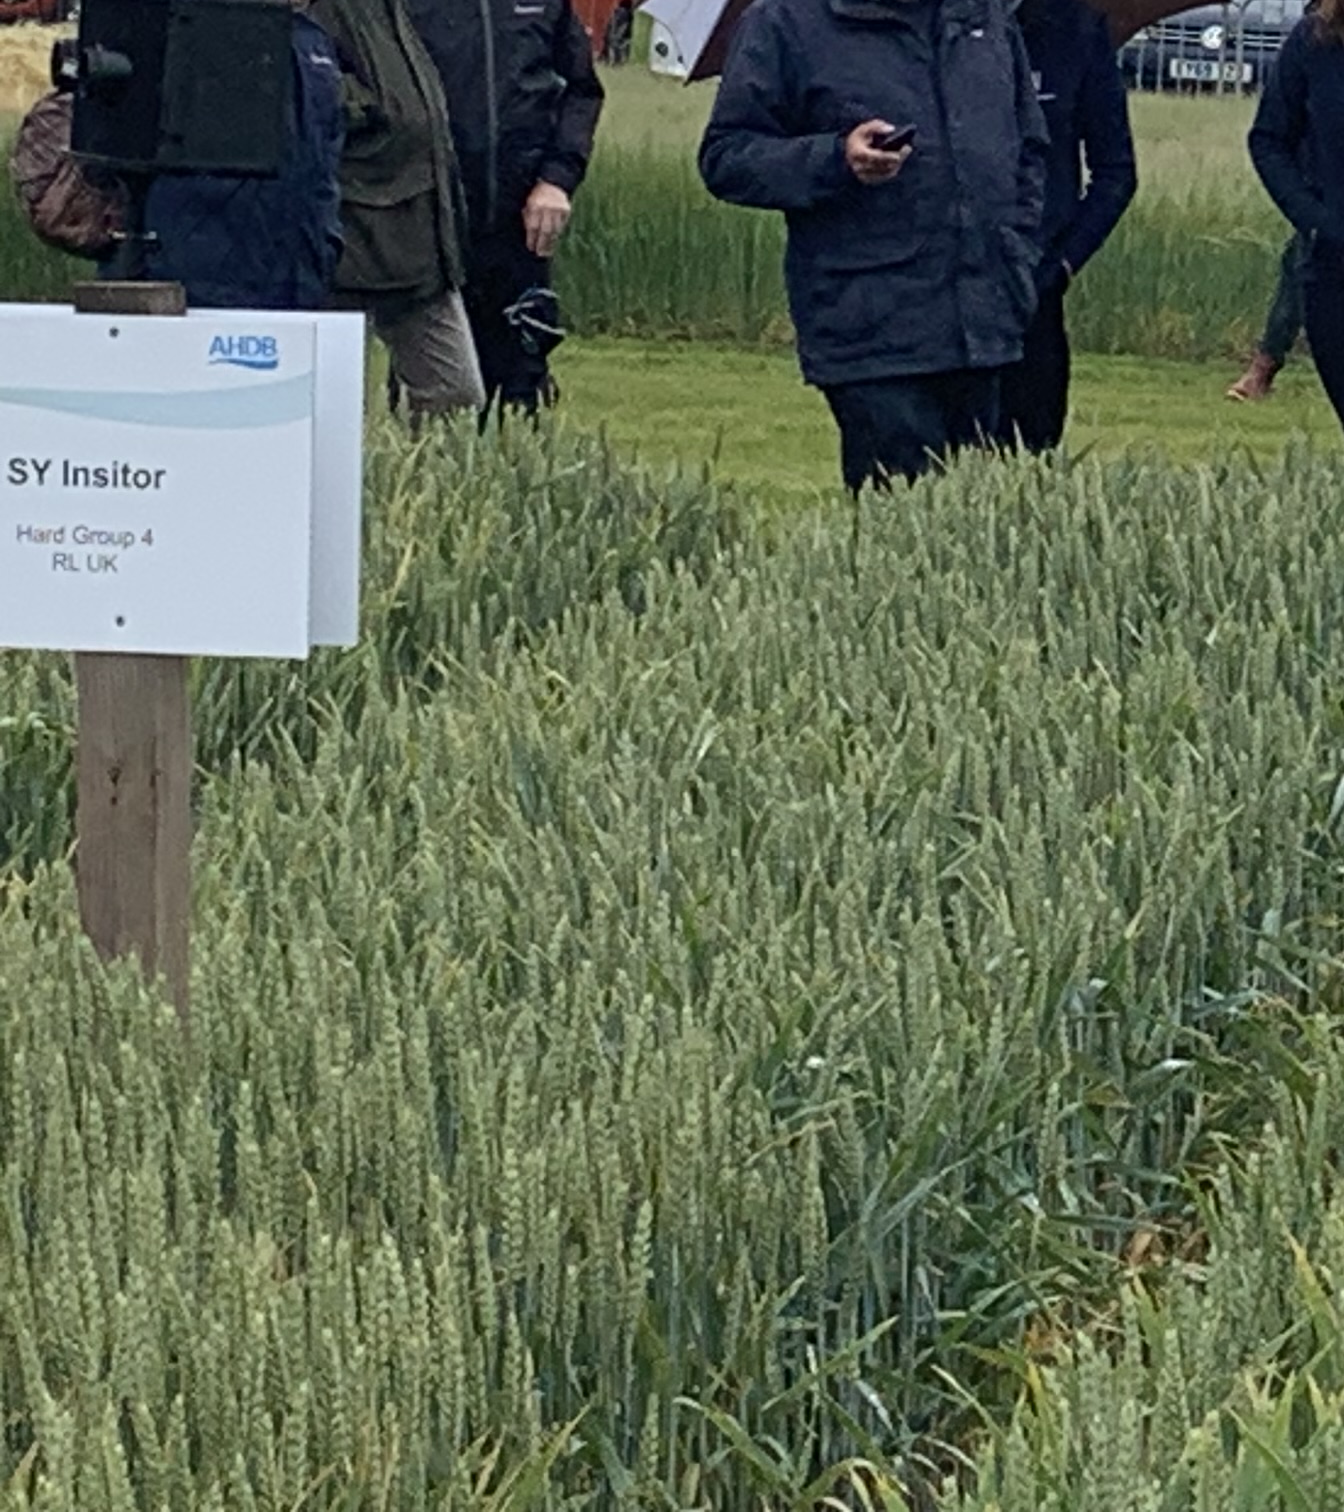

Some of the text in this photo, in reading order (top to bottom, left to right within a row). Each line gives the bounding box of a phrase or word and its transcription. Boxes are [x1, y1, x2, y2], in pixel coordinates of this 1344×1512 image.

[209, 335, 278, 358] AHDB
[7, 457, 167, 490] SY Insitor
[16, 524, 154, 549] Hard Group 4
[52, 553, 118, 574] RL UK
